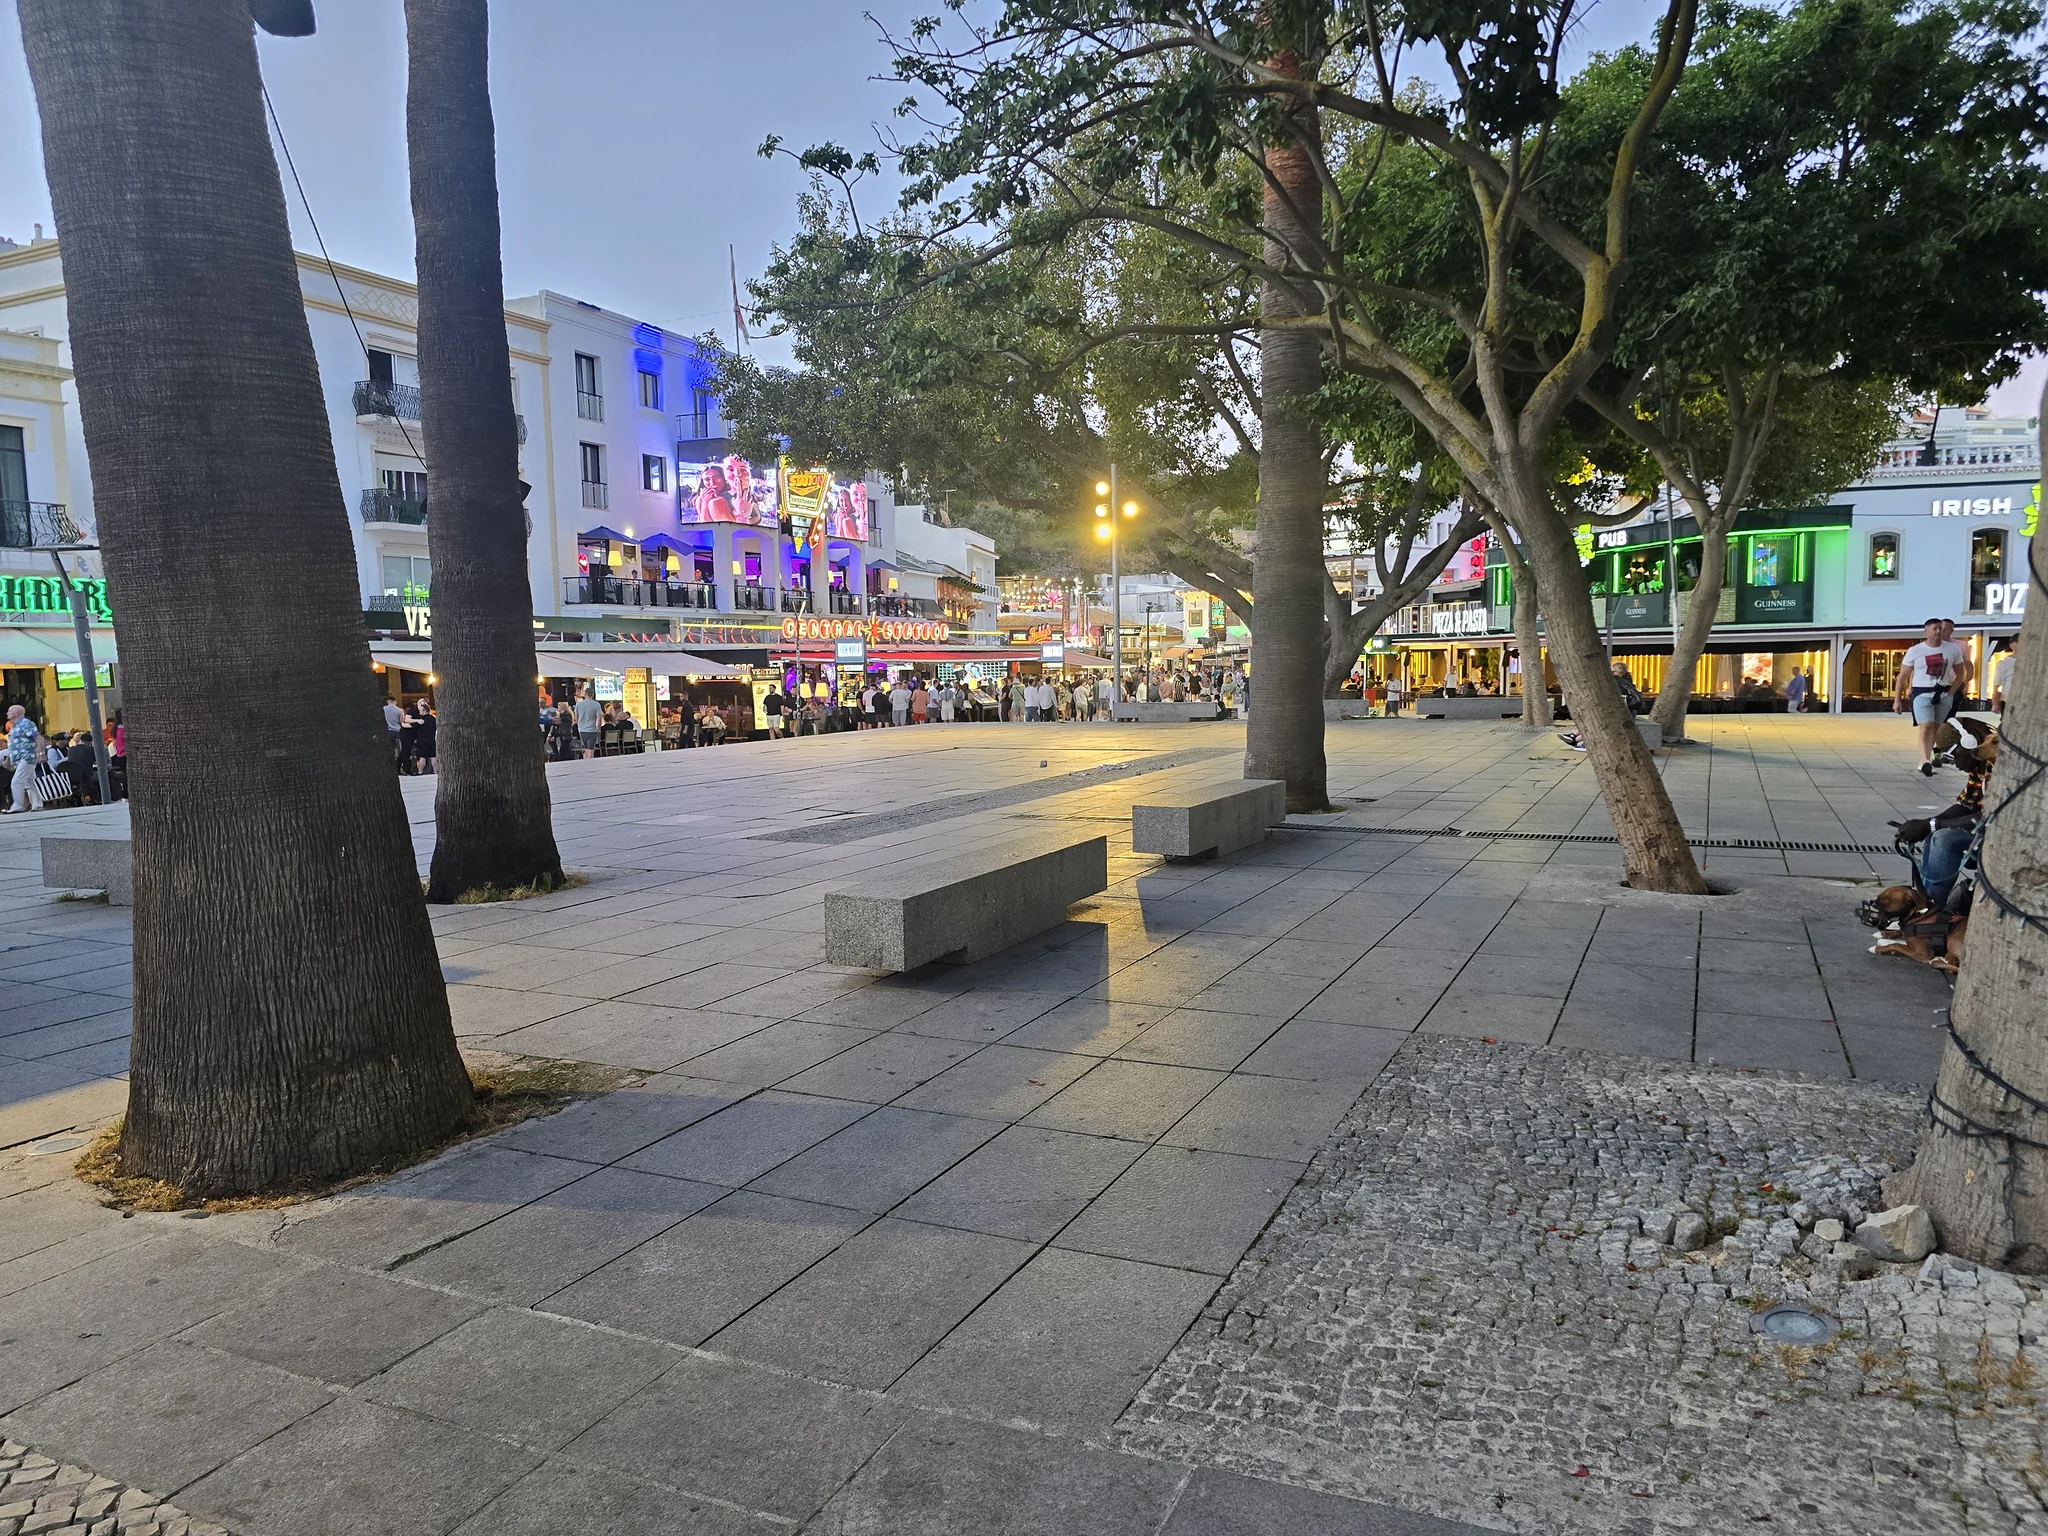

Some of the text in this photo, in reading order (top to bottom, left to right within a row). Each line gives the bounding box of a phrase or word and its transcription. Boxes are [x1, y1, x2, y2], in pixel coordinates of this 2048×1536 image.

[789, 474, 823, 487] STATION
[1931, 497, 2012, 517] IRISH
[1598, 530, 1628, 548] PUB
[1754, 599, 1797, 608] GUINNESS
[1625, 607, 1647, 616] GUINNESS
[1432, 608, 1488, 634] PIZZA & PASTA
[782, 617, 949, 640] CENTRAL STATION
[626, 674, 646, 682] PIZZA
[752, 668, 780, 676] VERTIGO
